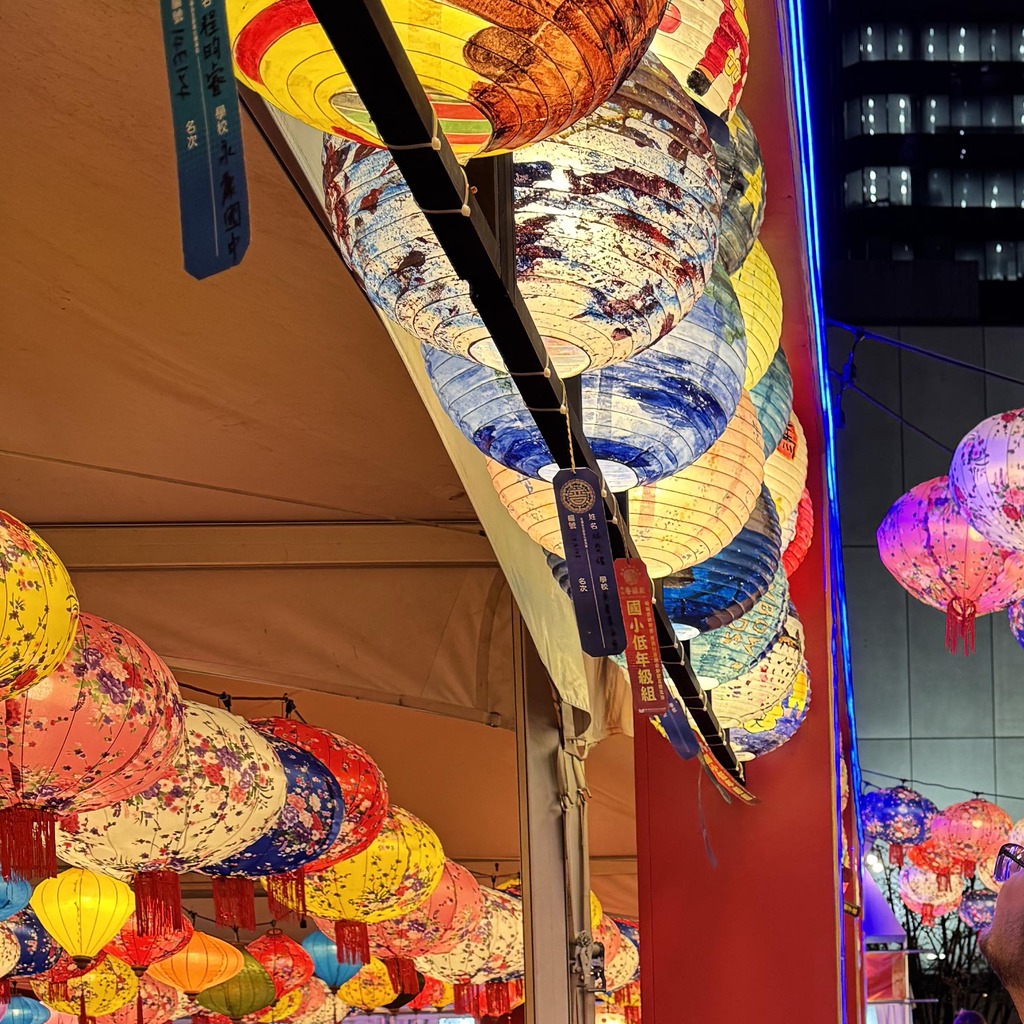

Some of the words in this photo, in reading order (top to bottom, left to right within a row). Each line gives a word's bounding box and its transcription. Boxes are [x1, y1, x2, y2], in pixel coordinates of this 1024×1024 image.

[185, 119, 199, 150] 名次
[588, 513, 598, 530] 姓名
[578, 577, 589, 592] 名次
[626, 599, 657, 702] 國小低年級組
